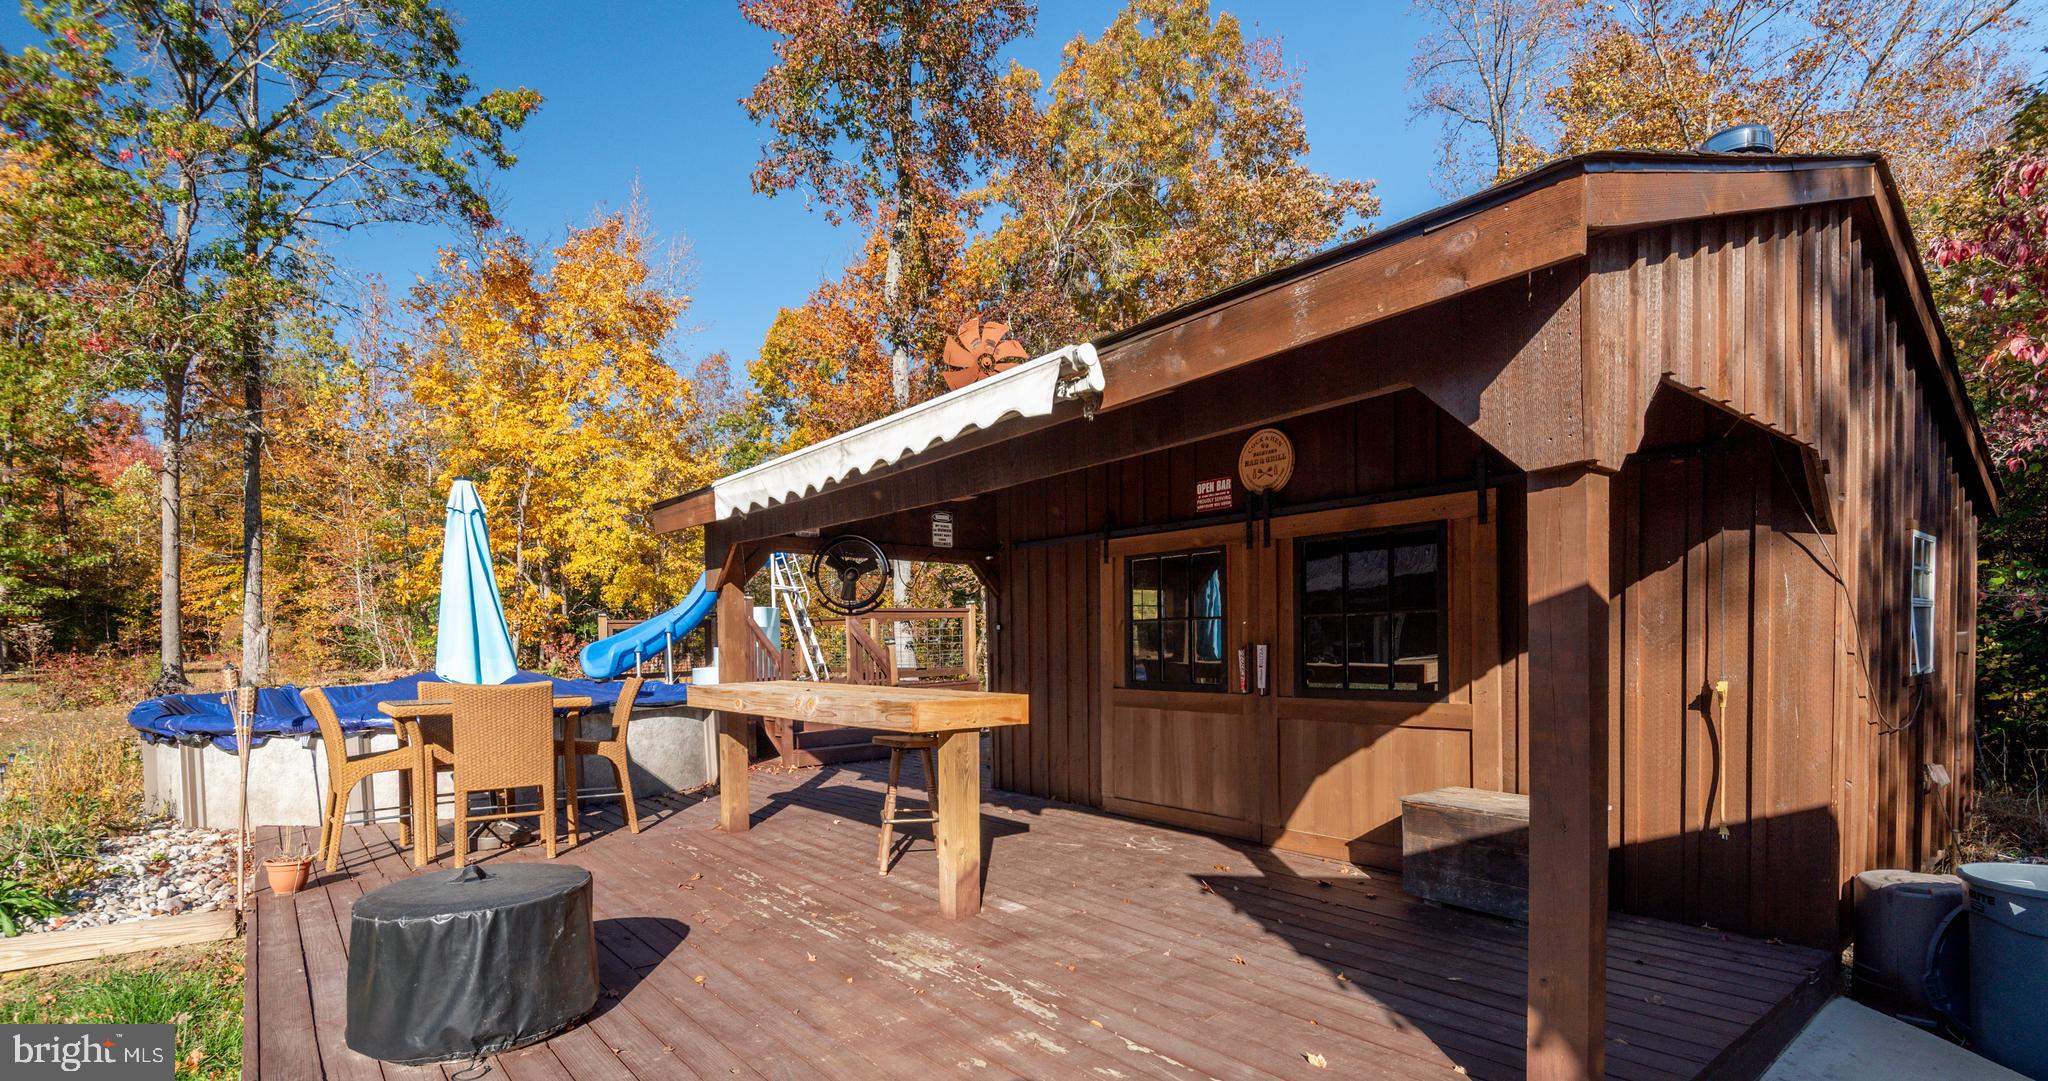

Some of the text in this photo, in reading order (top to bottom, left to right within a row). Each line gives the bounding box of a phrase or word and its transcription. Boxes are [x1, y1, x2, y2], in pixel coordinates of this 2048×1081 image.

[1196, 481, 1215, 495] OPEN
[1216, 478, 1232, 491] BAR
[1196, 497, 1214, 505] PROUDLY
[1967, 887, 1995, 906] RUTE
